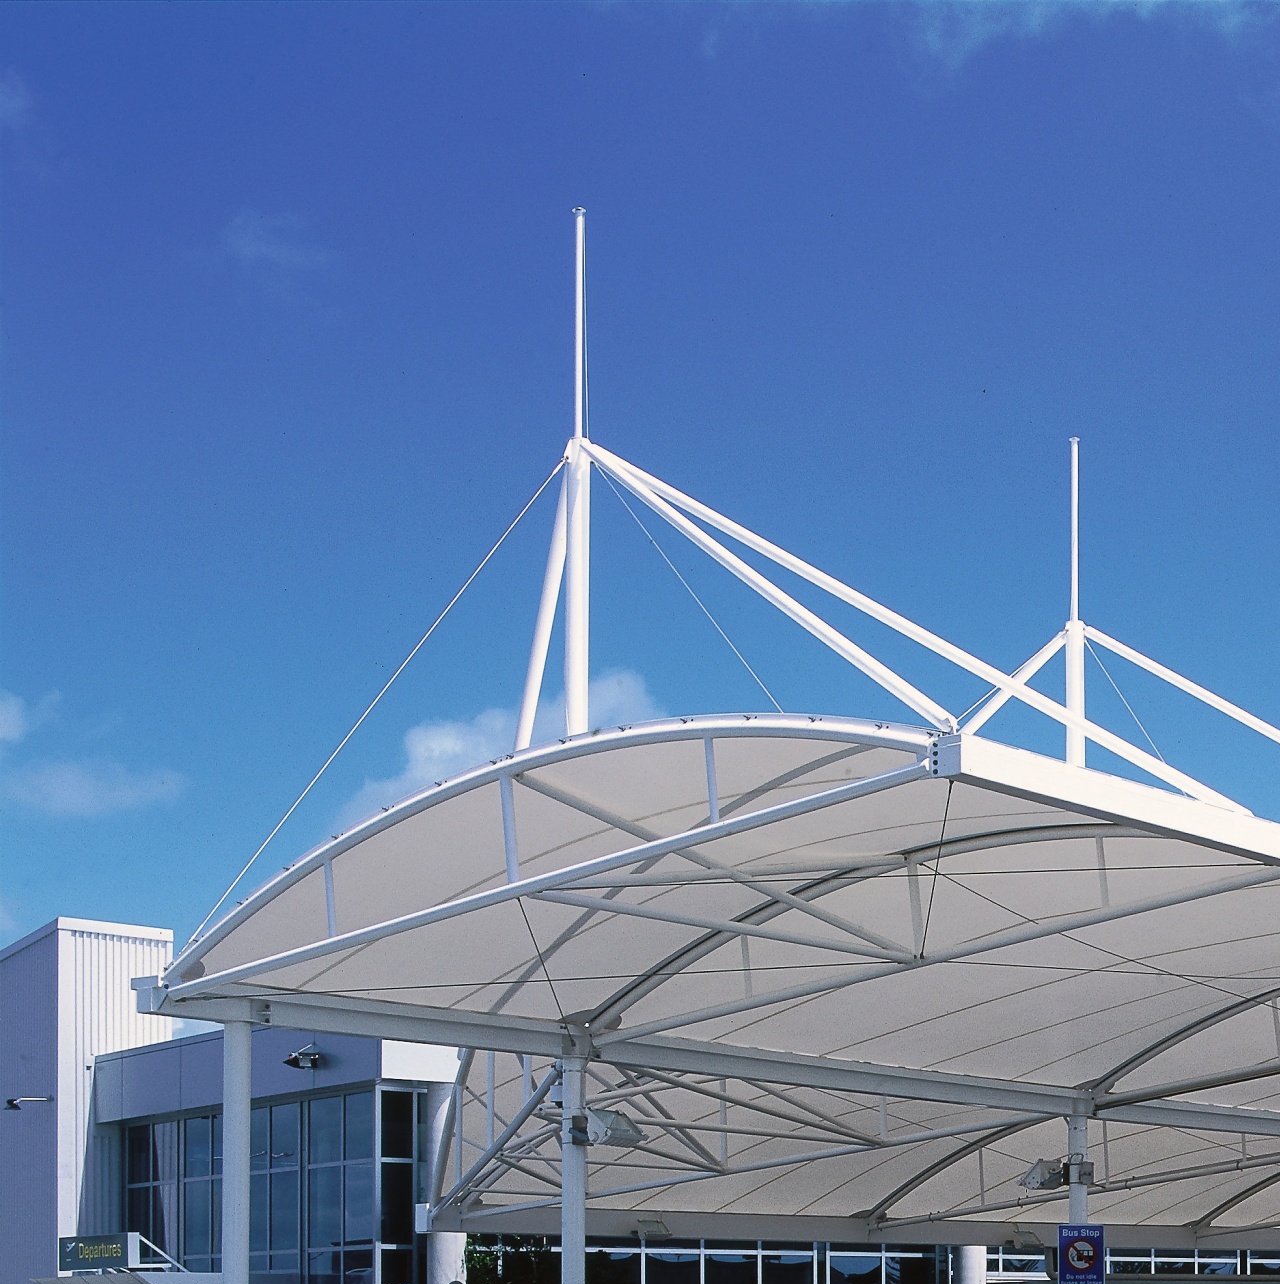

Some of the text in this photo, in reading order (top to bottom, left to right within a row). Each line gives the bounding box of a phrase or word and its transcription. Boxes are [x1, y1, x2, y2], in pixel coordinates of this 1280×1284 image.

[1062, 1229, 1100, 1238] Bus Stop
[78, 1243, 122, 1262] Departures
